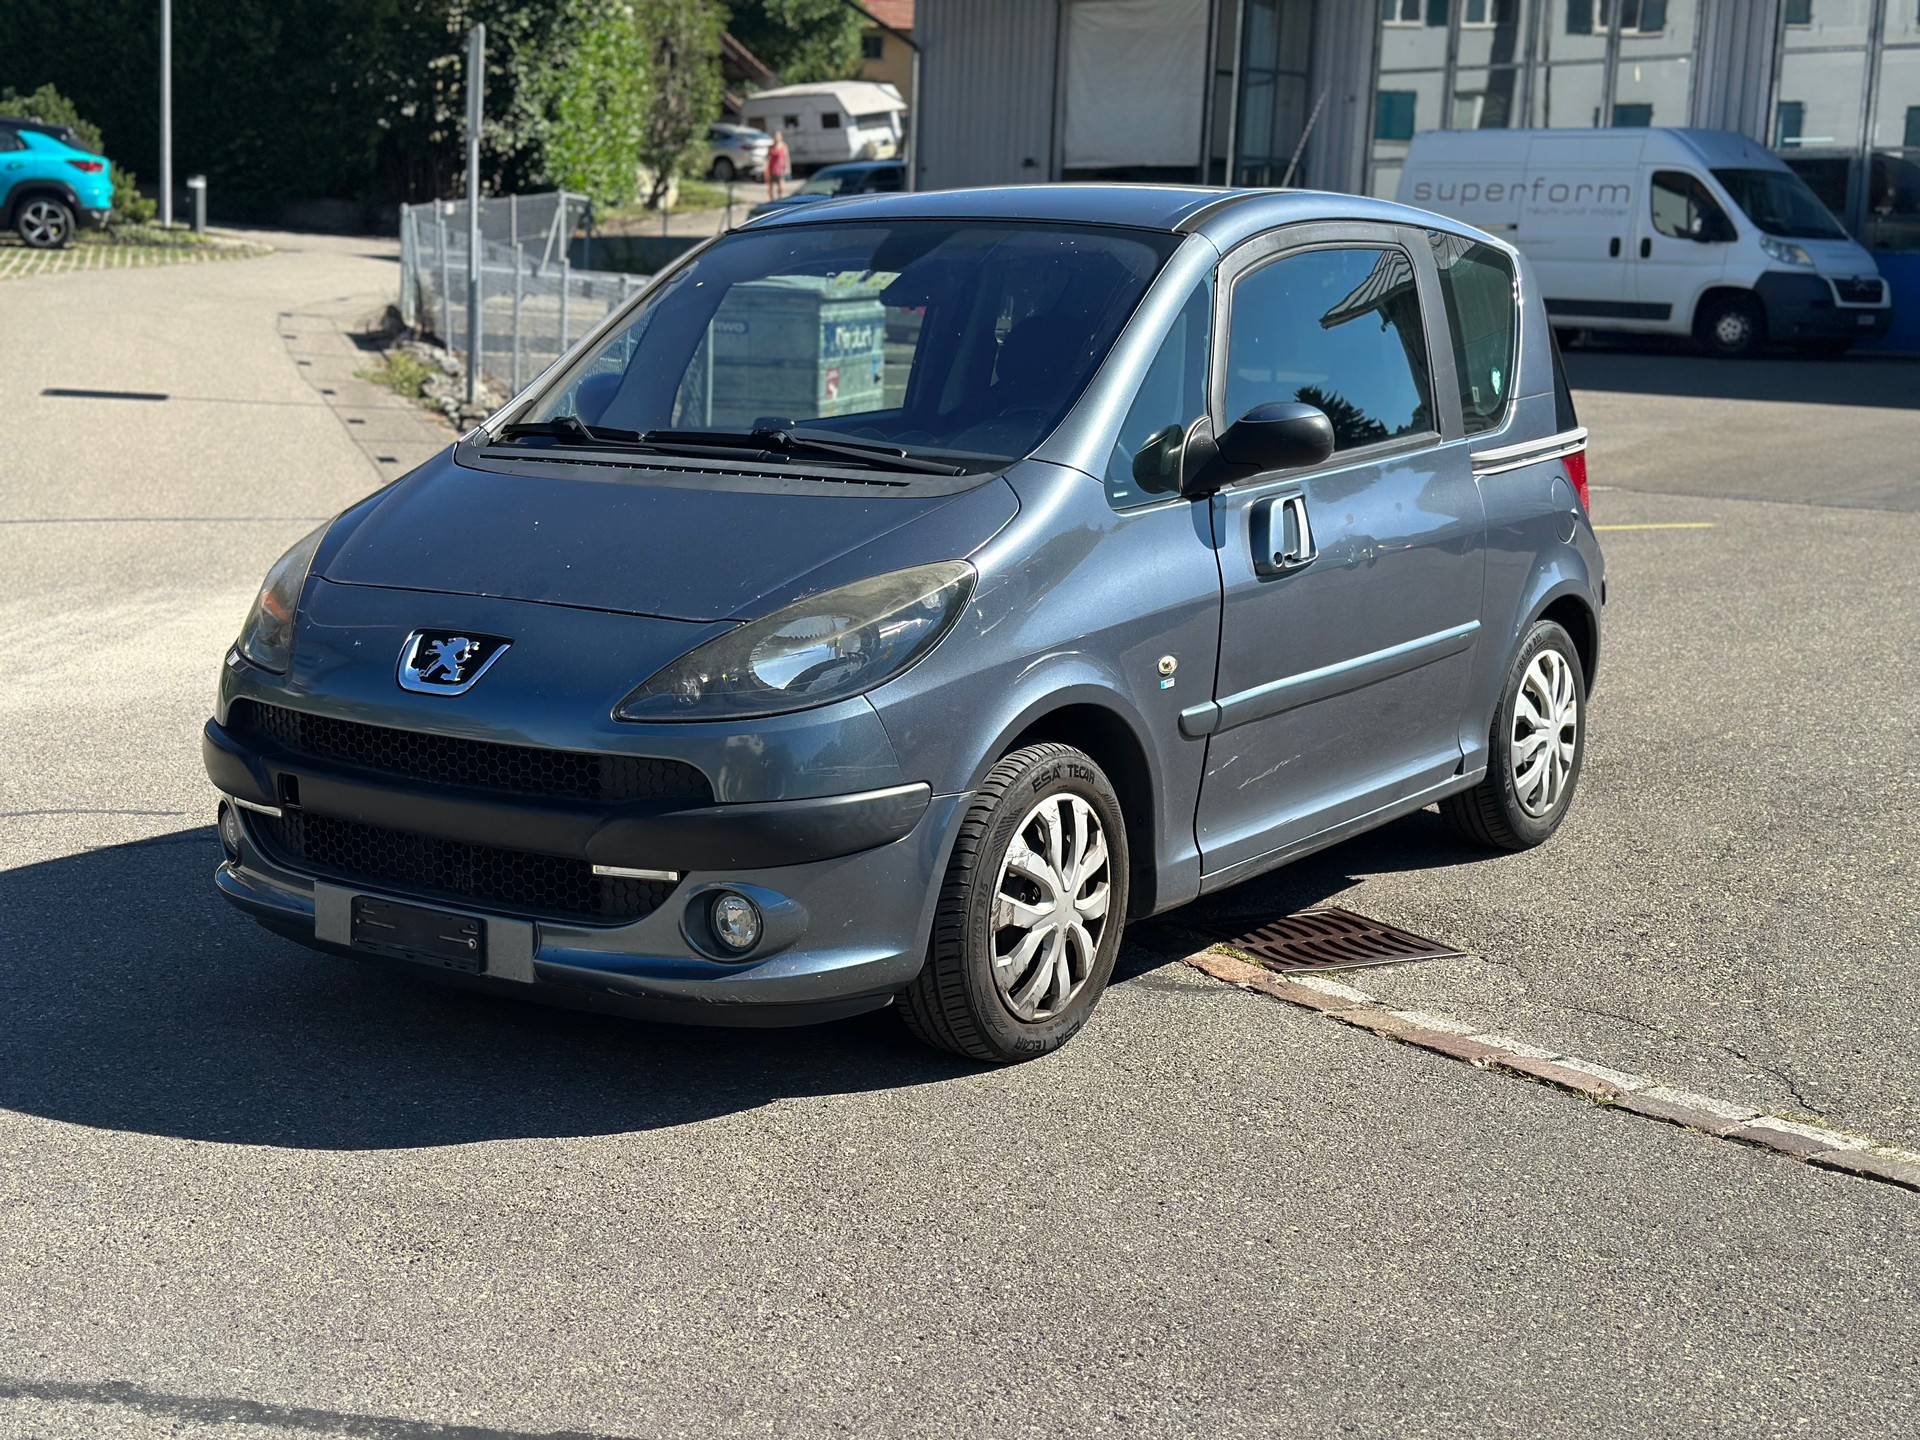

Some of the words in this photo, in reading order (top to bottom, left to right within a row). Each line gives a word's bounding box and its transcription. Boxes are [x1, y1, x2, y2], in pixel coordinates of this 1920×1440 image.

[1412, 176, 1631, 206] superform
[1066, 764, 1096, 785] TECAR
[1013, 1036, 1048, 1053] TECAR
